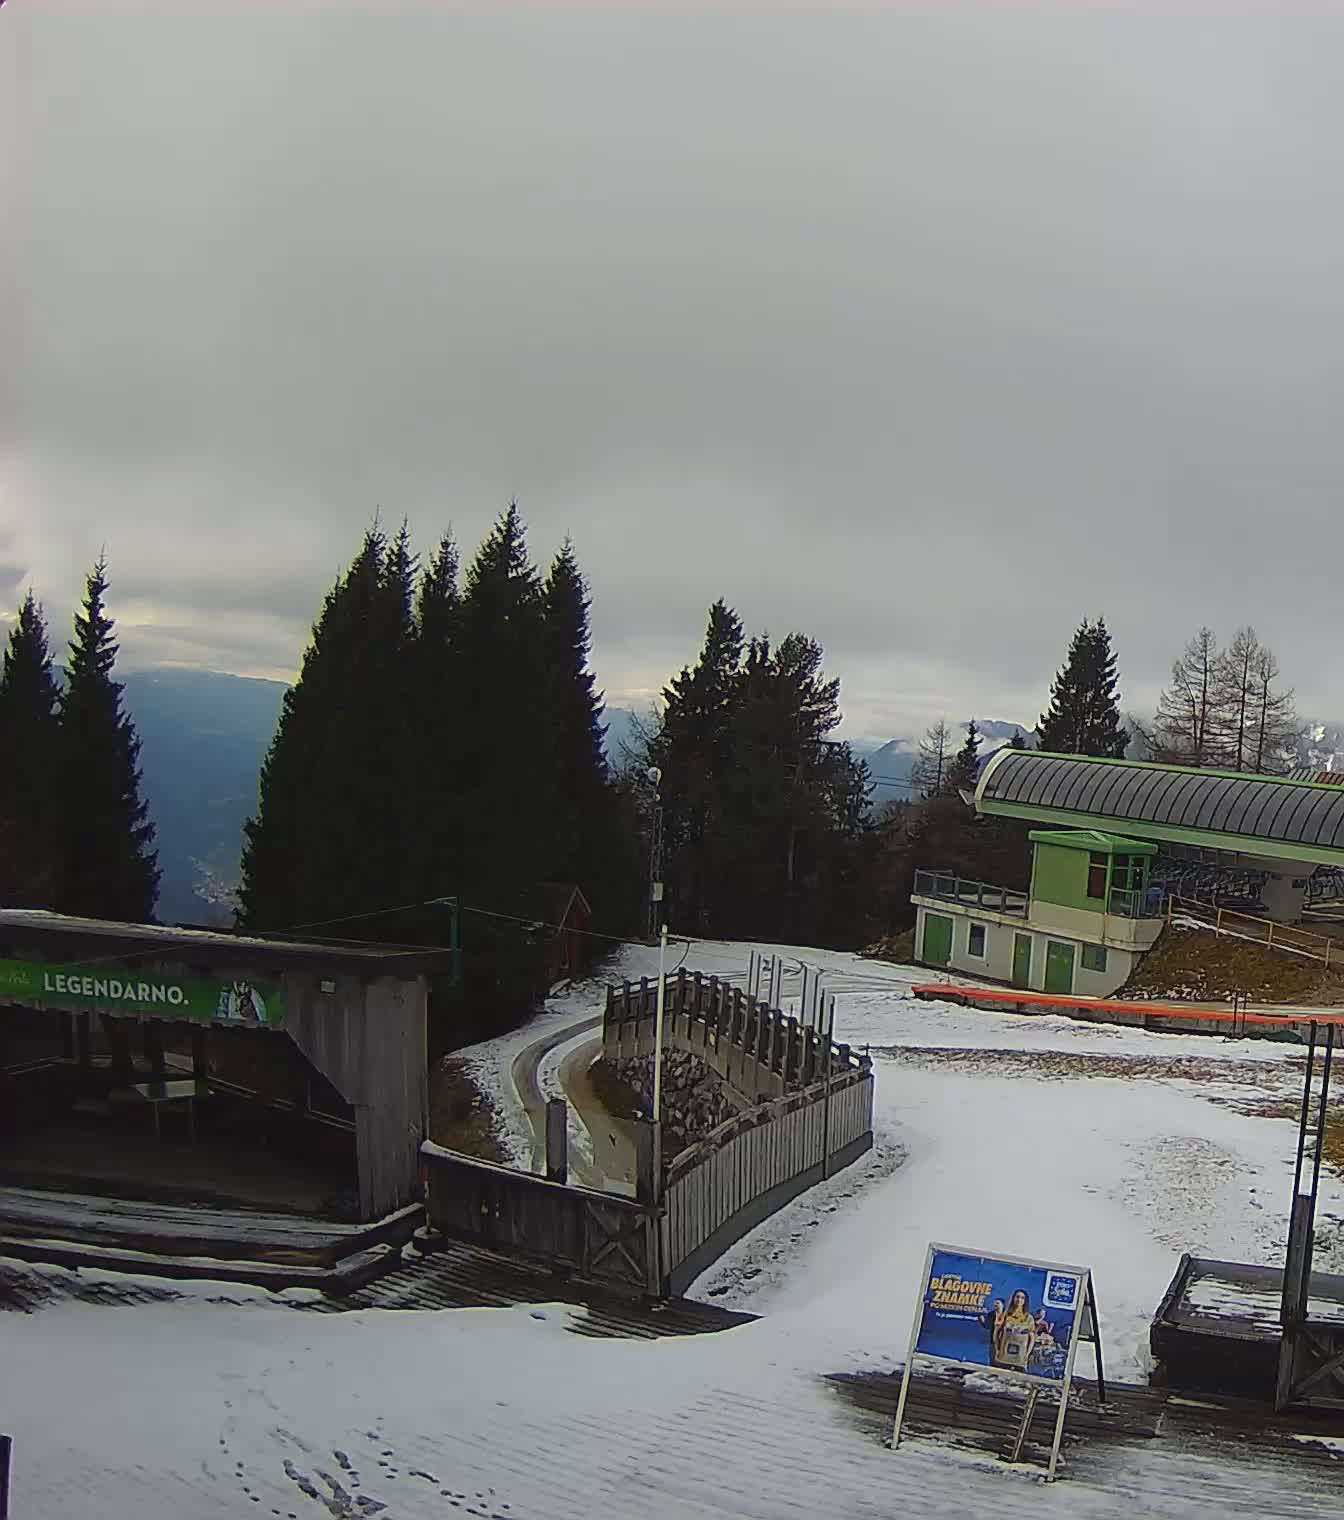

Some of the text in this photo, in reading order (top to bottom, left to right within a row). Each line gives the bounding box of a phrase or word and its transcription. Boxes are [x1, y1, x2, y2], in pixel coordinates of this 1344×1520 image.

[44, 972, 189, 1005] LEGENDARNO.
[930, 1277, 992, 1295] BLAGOVNE
[932, 1290, 987, 1306] ZNAMKE
